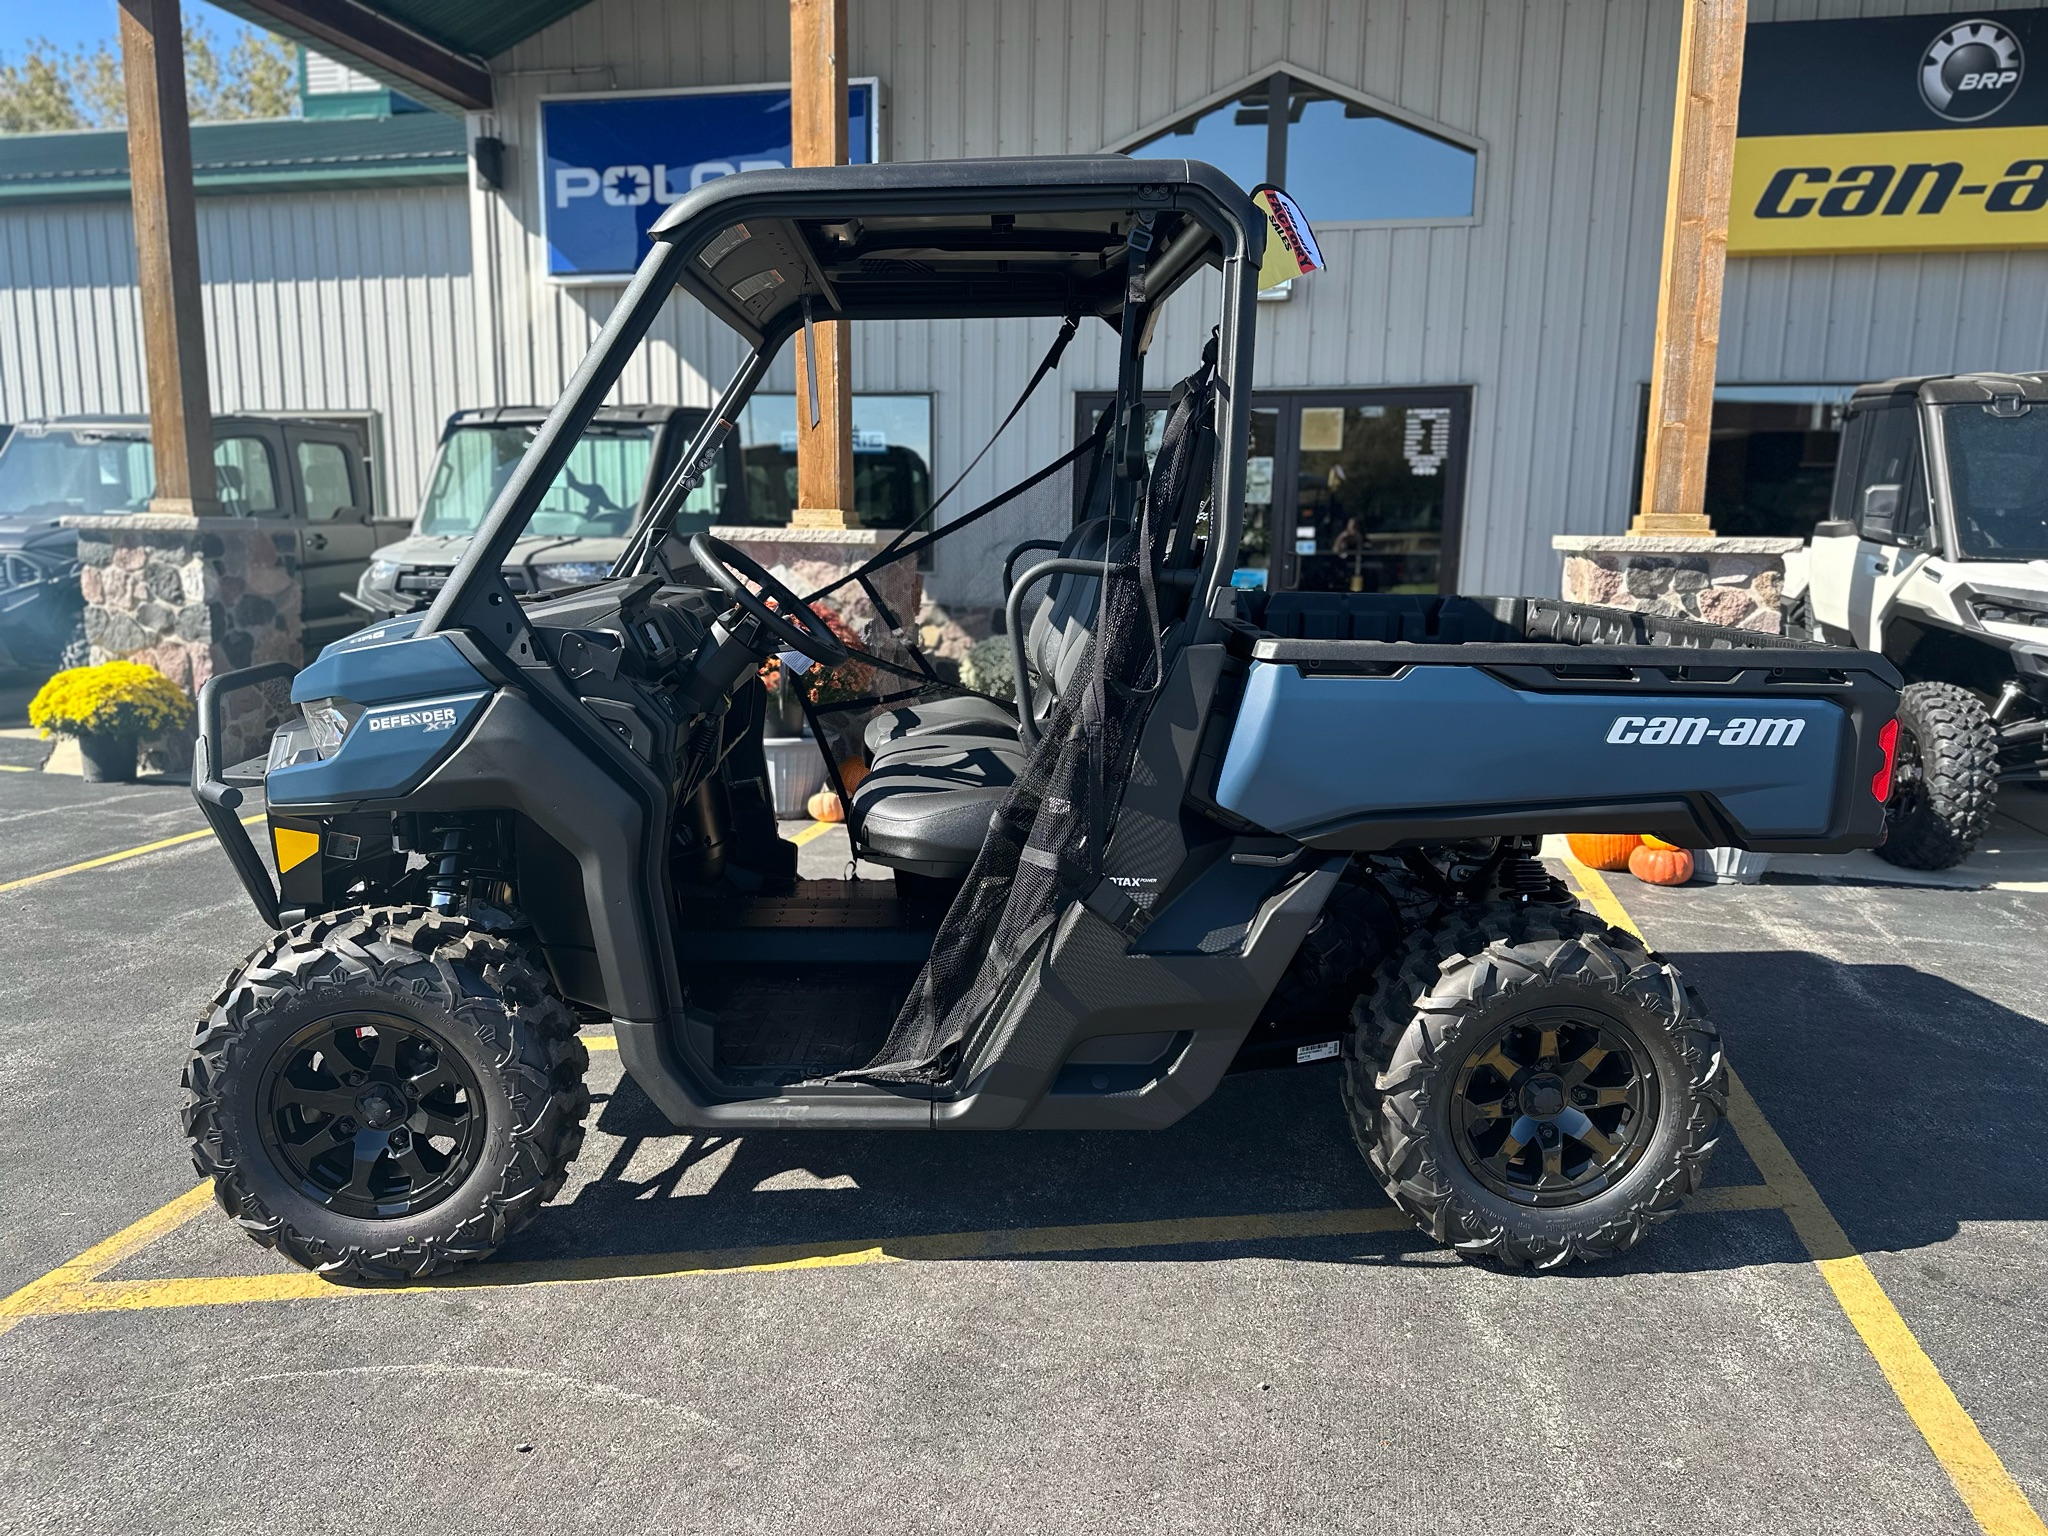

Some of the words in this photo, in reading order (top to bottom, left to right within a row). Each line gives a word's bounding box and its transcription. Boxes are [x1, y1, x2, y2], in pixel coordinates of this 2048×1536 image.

[1958, 71, 2017, 91] BRP
[1267, 193, 1313, 266] FACTORY
[1268, 214, 1293, 252] SALES
[369, 708, 455, 731] DEFENDER
[423, 719, 456, 733] XT
[1606, 716, 1806, 746] can-am
